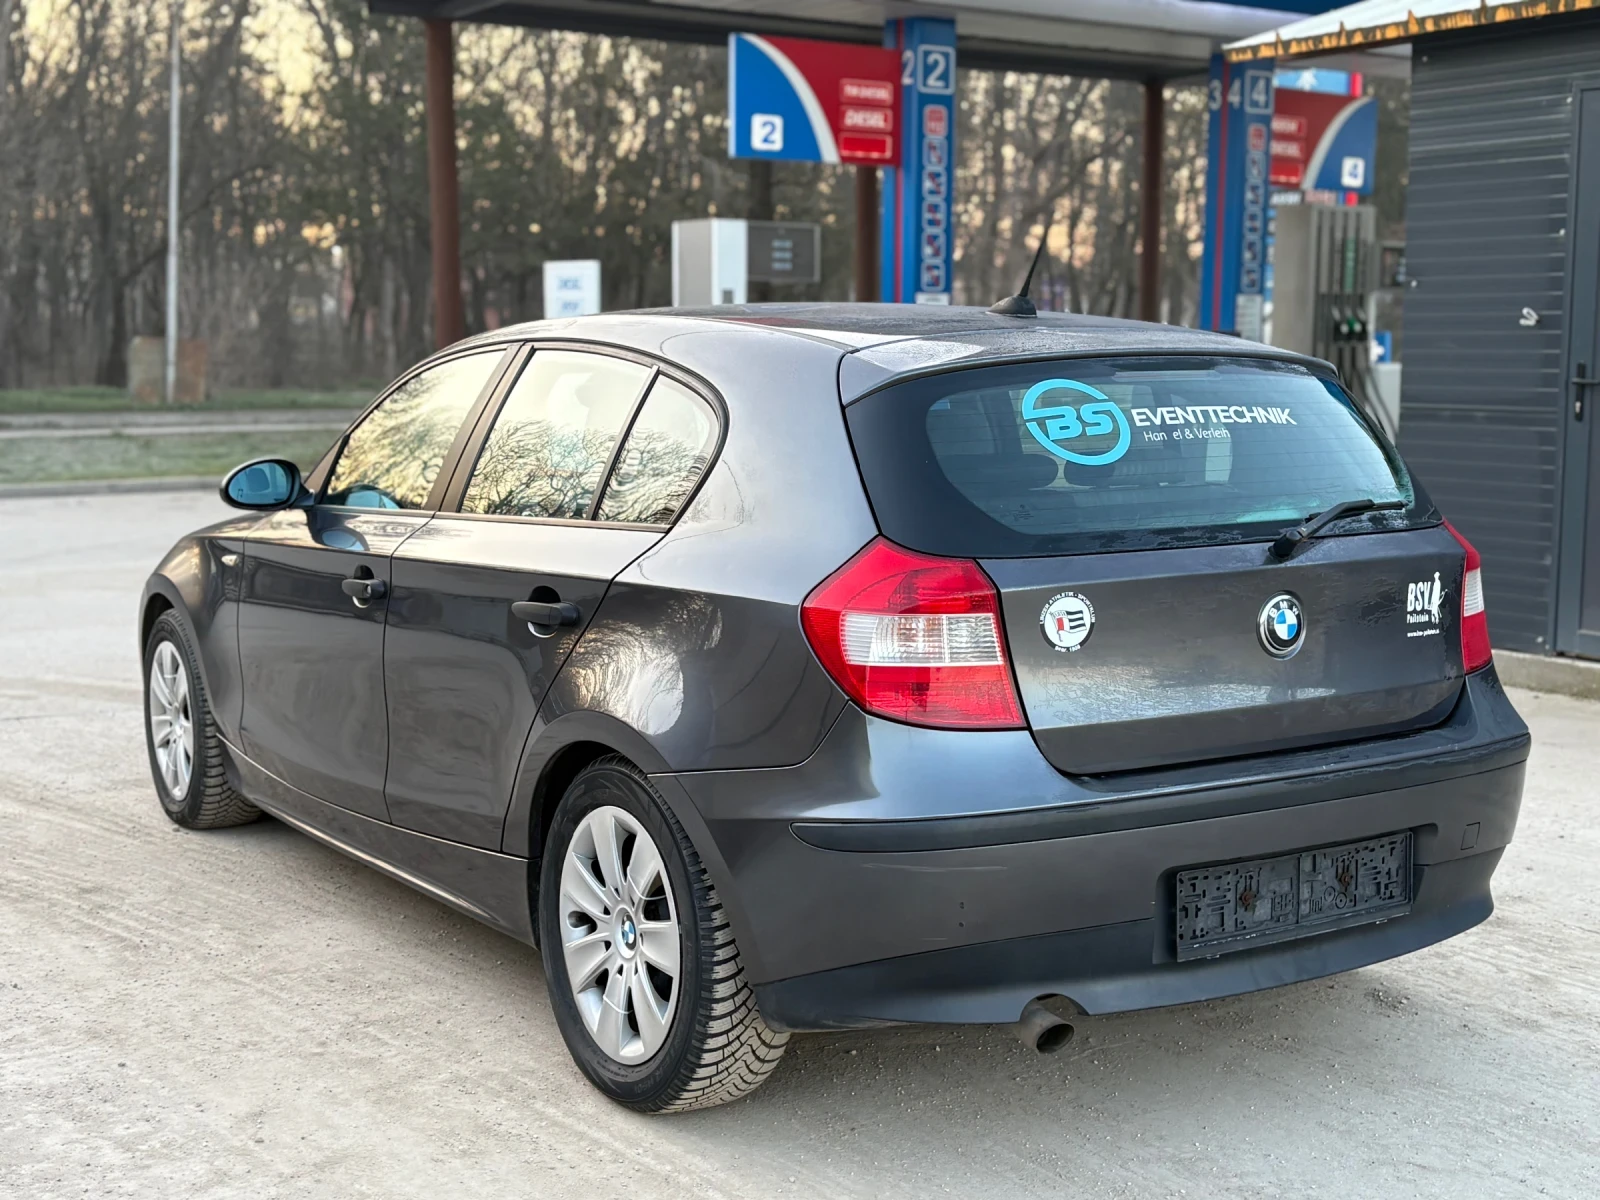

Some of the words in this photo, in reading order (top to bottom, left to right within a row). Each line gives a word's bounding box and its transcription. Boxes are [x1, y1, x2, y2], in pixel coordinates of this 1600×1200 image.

[926, 54, 946, 87] 2
[1209, 82, 1222, 110] 3
[1227, 79, 1241, 109] 4
[1251, 78, 1267, 106] 4
[761, 121, 776, 144] 2
[1046, 402, 1114, 441] BS
[1131, 405, 1298, 426] EVENTTECHNIK
[1184, 428, 1194, 439] &
[1195, 427, 1231, 439] Verleih
[1269, 601, 1298, 617] BMW
[1407, 581, 1432, 612] BSV
